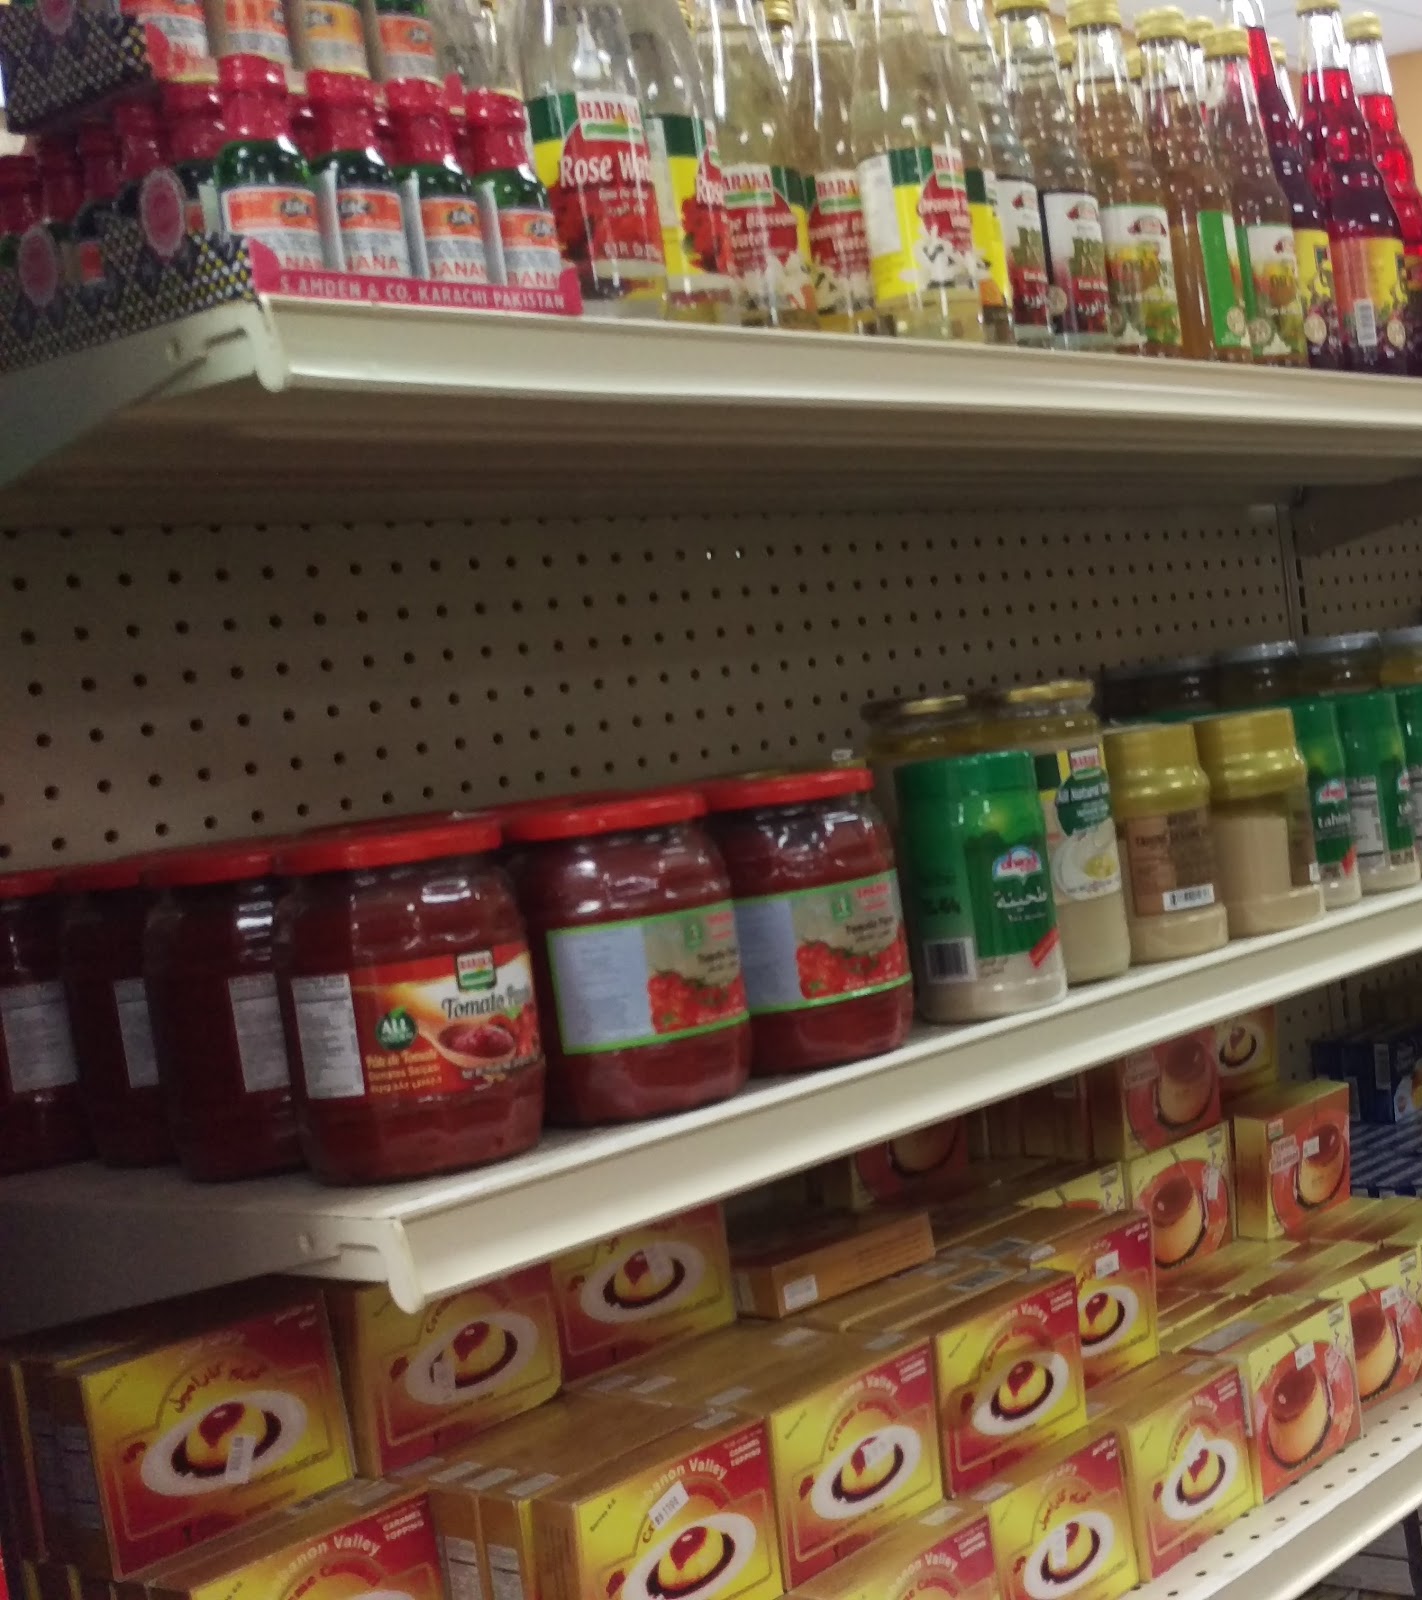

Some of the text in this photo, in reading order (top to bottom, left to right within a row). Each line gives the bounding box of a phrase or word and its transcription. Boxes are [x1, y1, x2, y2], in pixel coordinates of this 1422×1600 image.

[561, 154, 614, 188] Rose
[418, 285, 488, 306] KARACHI
[493, 287, 566, 311] PAKISTAN
[440, 992, 504, 1019] Tomato
[688, 1457, 728, 1481] Valley
[385, 1519, 425, 1542] TOPPING
[332, 1533, 381, 1557] Valley
[924, 1551, 959, 1573] Valley
